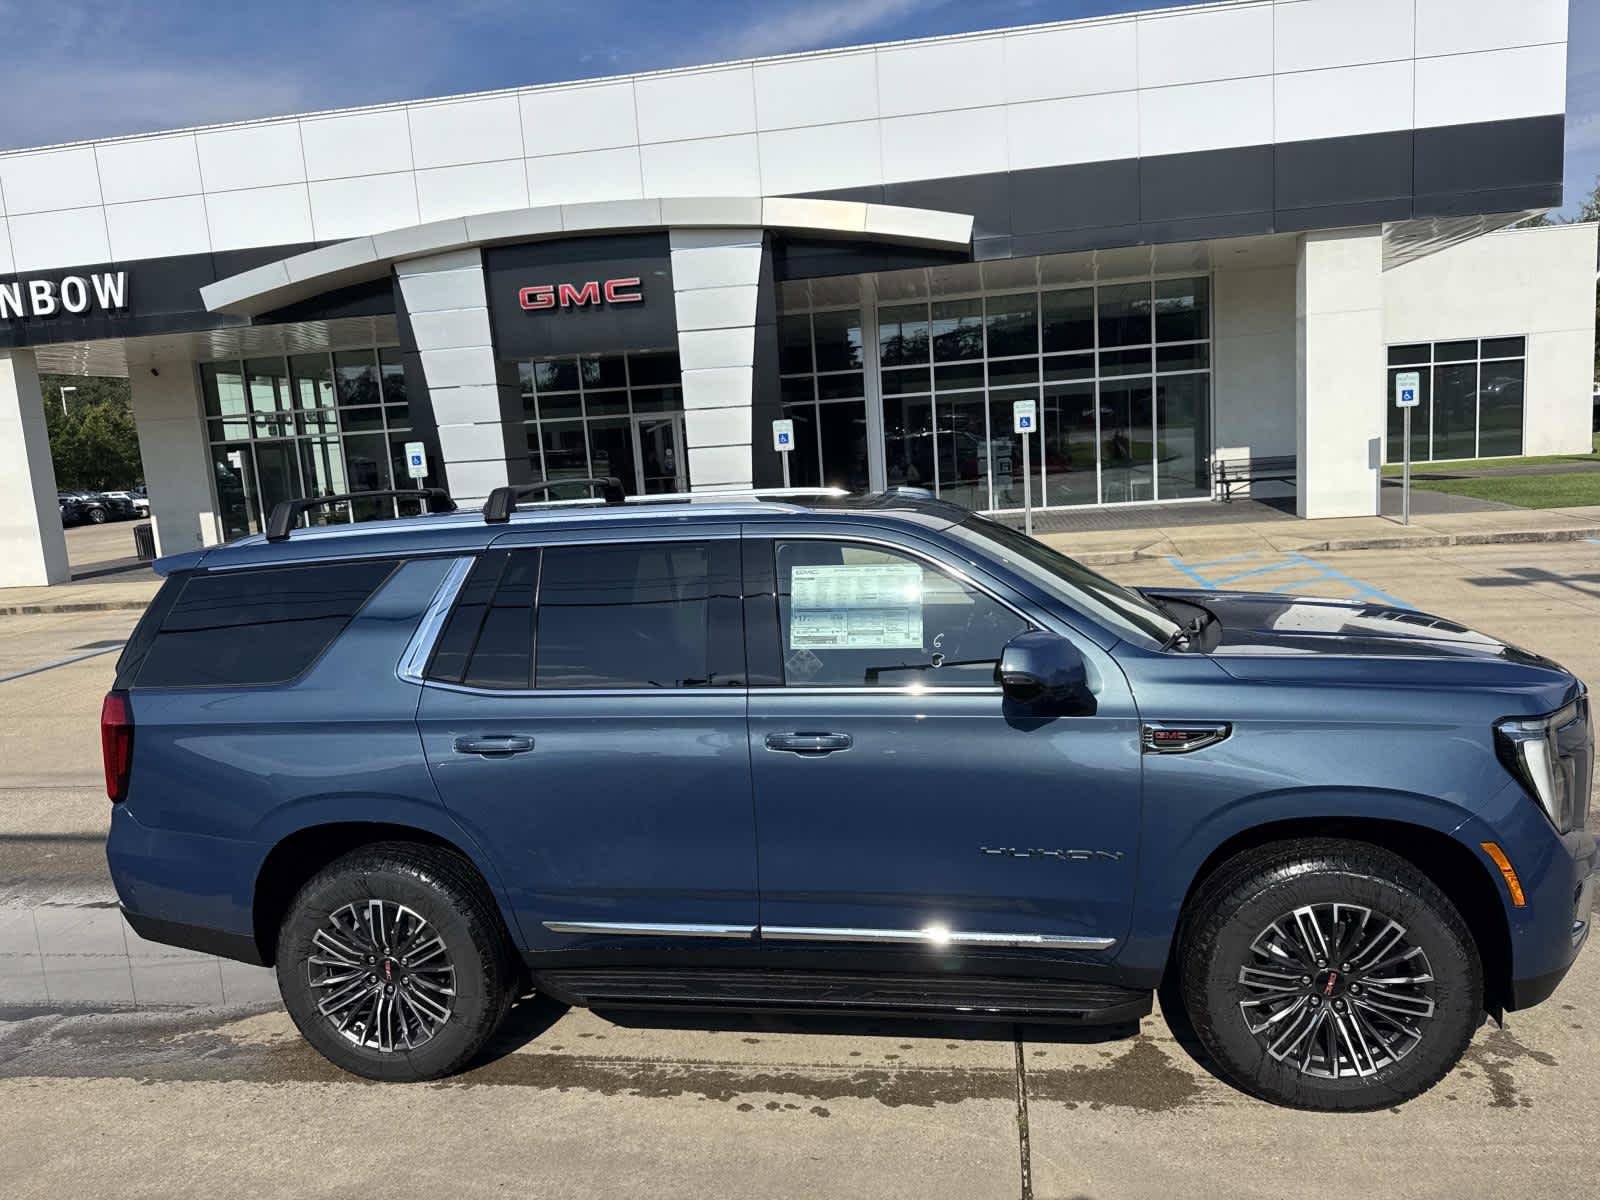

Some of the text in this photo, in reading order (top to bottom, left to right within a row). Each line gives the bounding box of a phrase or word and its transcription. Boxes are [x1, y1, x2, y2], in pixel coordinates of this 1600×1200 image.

[0, 272, 126, 319] NBOW
[518, 277, 642, 310] GMC
[1155, 731, 1188, 739] GMC
